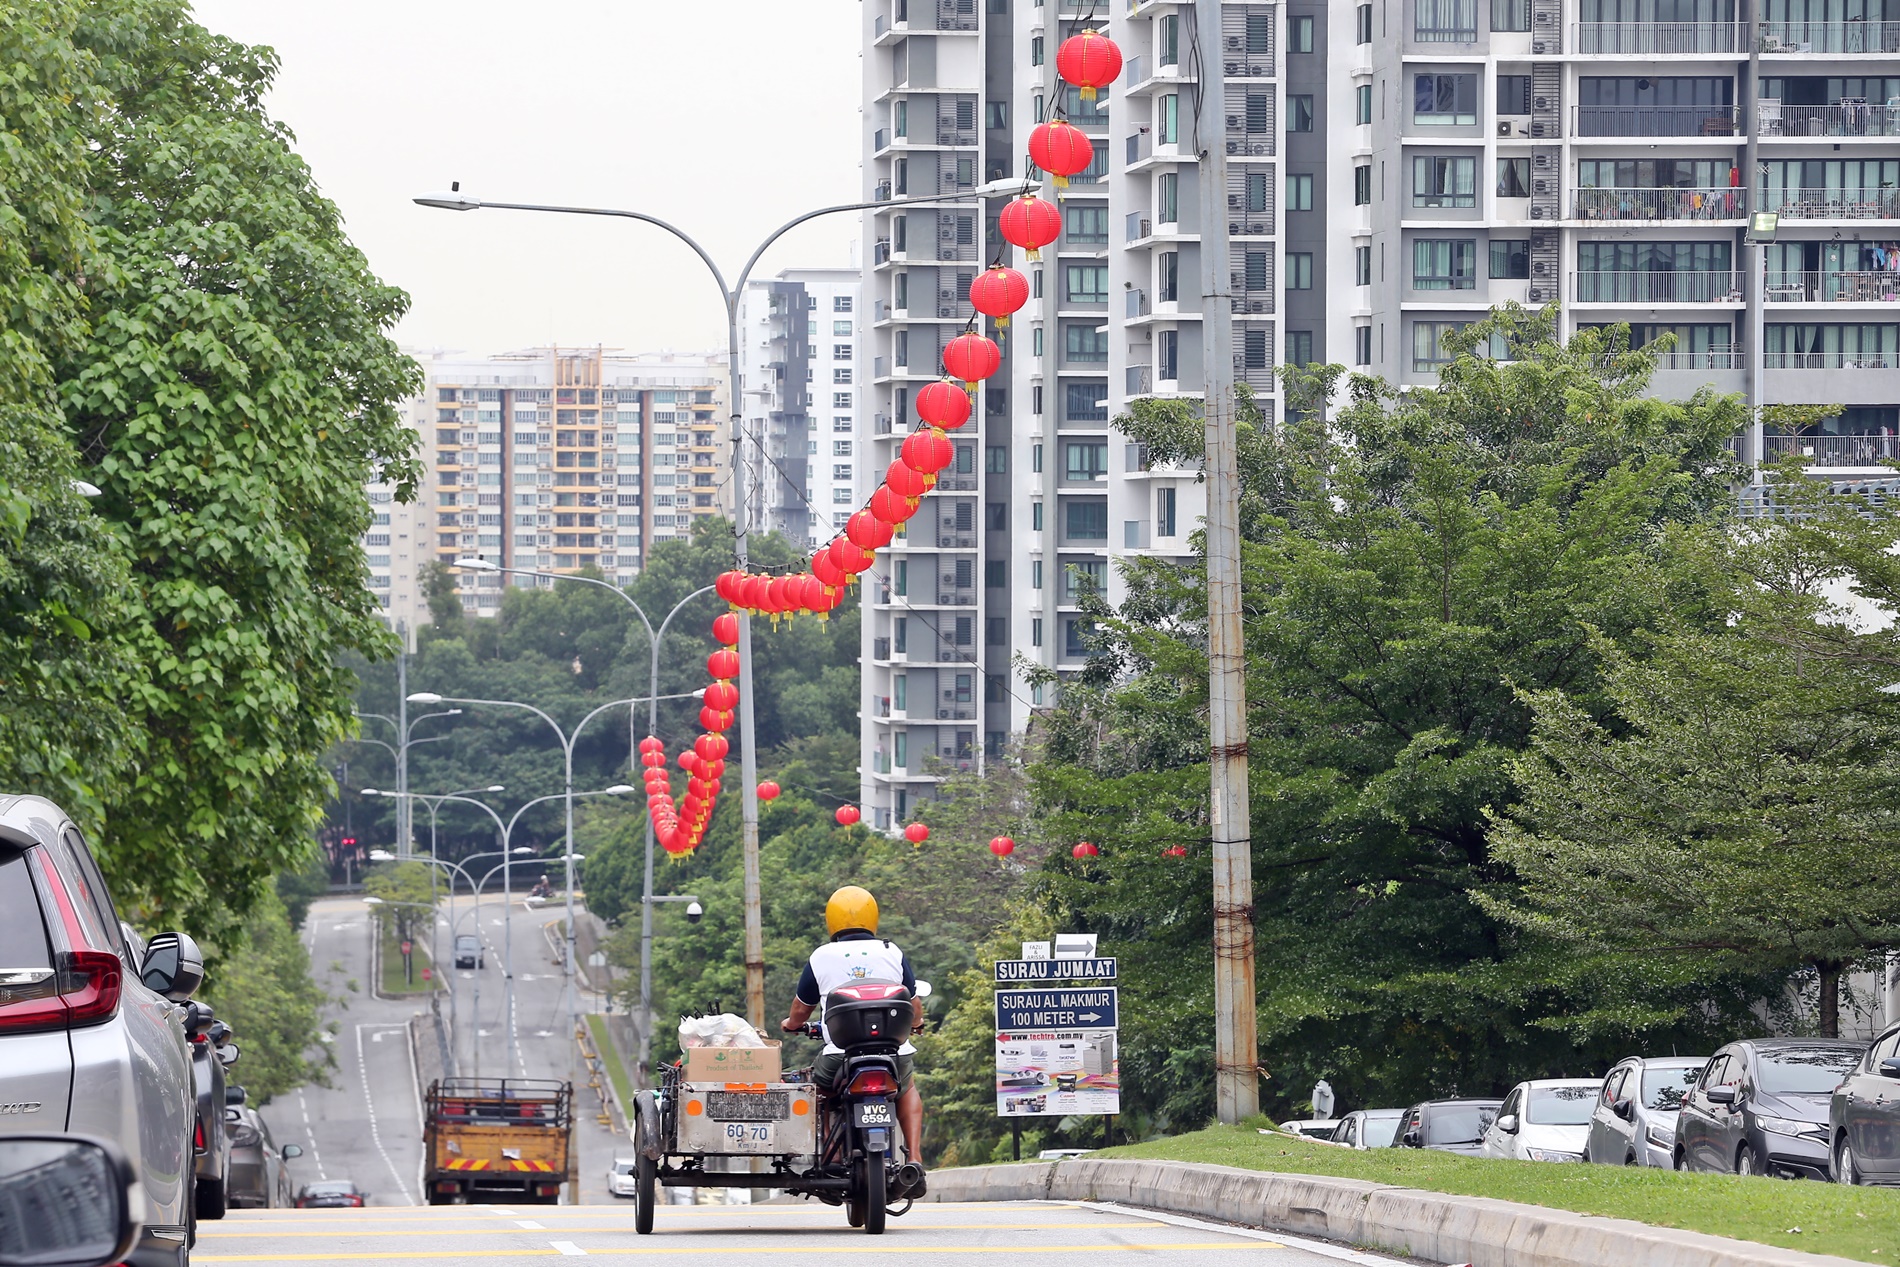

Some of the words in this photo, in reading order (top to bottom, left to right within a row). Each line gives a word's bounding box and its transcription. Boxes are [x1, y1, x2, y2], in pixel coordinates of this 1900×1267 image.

[998, 962, 1048, 979] SURAU
[1053, 960, 1113, 978] JUMAAT
[1002, 995, 1041, 1009] SURAU
[1042, 994, 1059, 1008] AL
[1060, 993, 1110, 1008] MAKMUR
[1011, 1012, 1031, 1026] 100
[1033, 1011, 1076, 1025] METER
[1011, 1032, 1084, 1041] www.techtra.com.my
[863, 1105, 887, 1115] WVG
[861, 1114, 891, 1124] 6594
[727, 1124, 744, 1138] 60
[751, 1127, 768, 1141] 70
